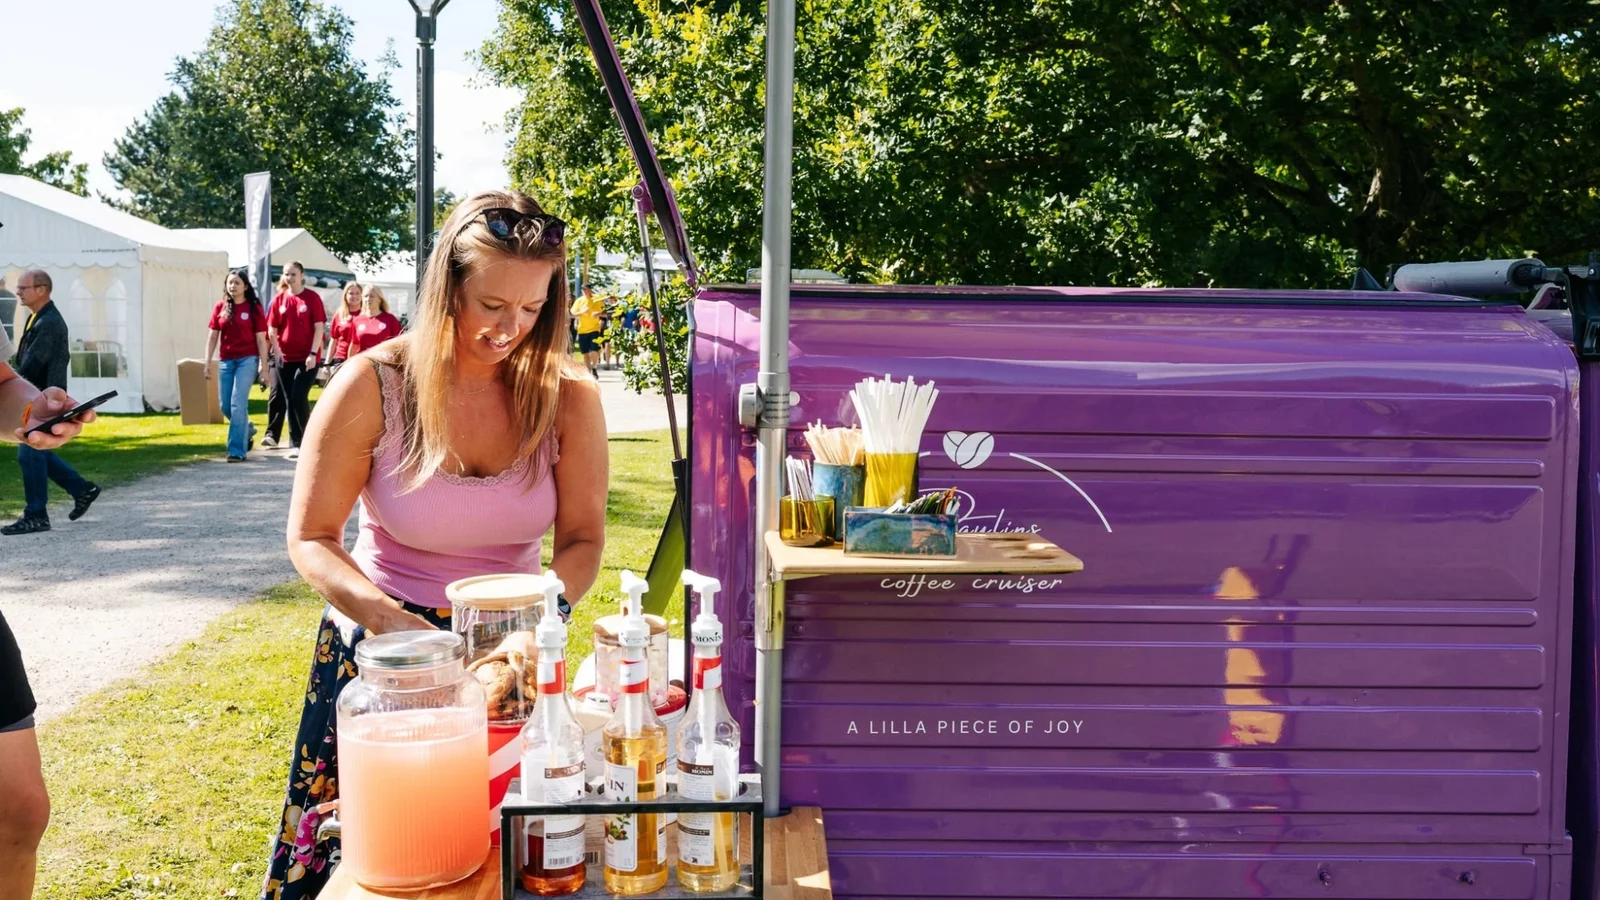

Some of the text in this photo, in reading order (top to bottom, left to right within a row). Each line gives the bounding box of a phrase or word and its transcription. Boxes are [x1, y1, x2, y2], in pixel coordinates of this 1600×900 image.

[880, 575, 1063, 597] coffee cruiser
[847, 720, 1084, 734] A LILLA PIECE OF JOY
